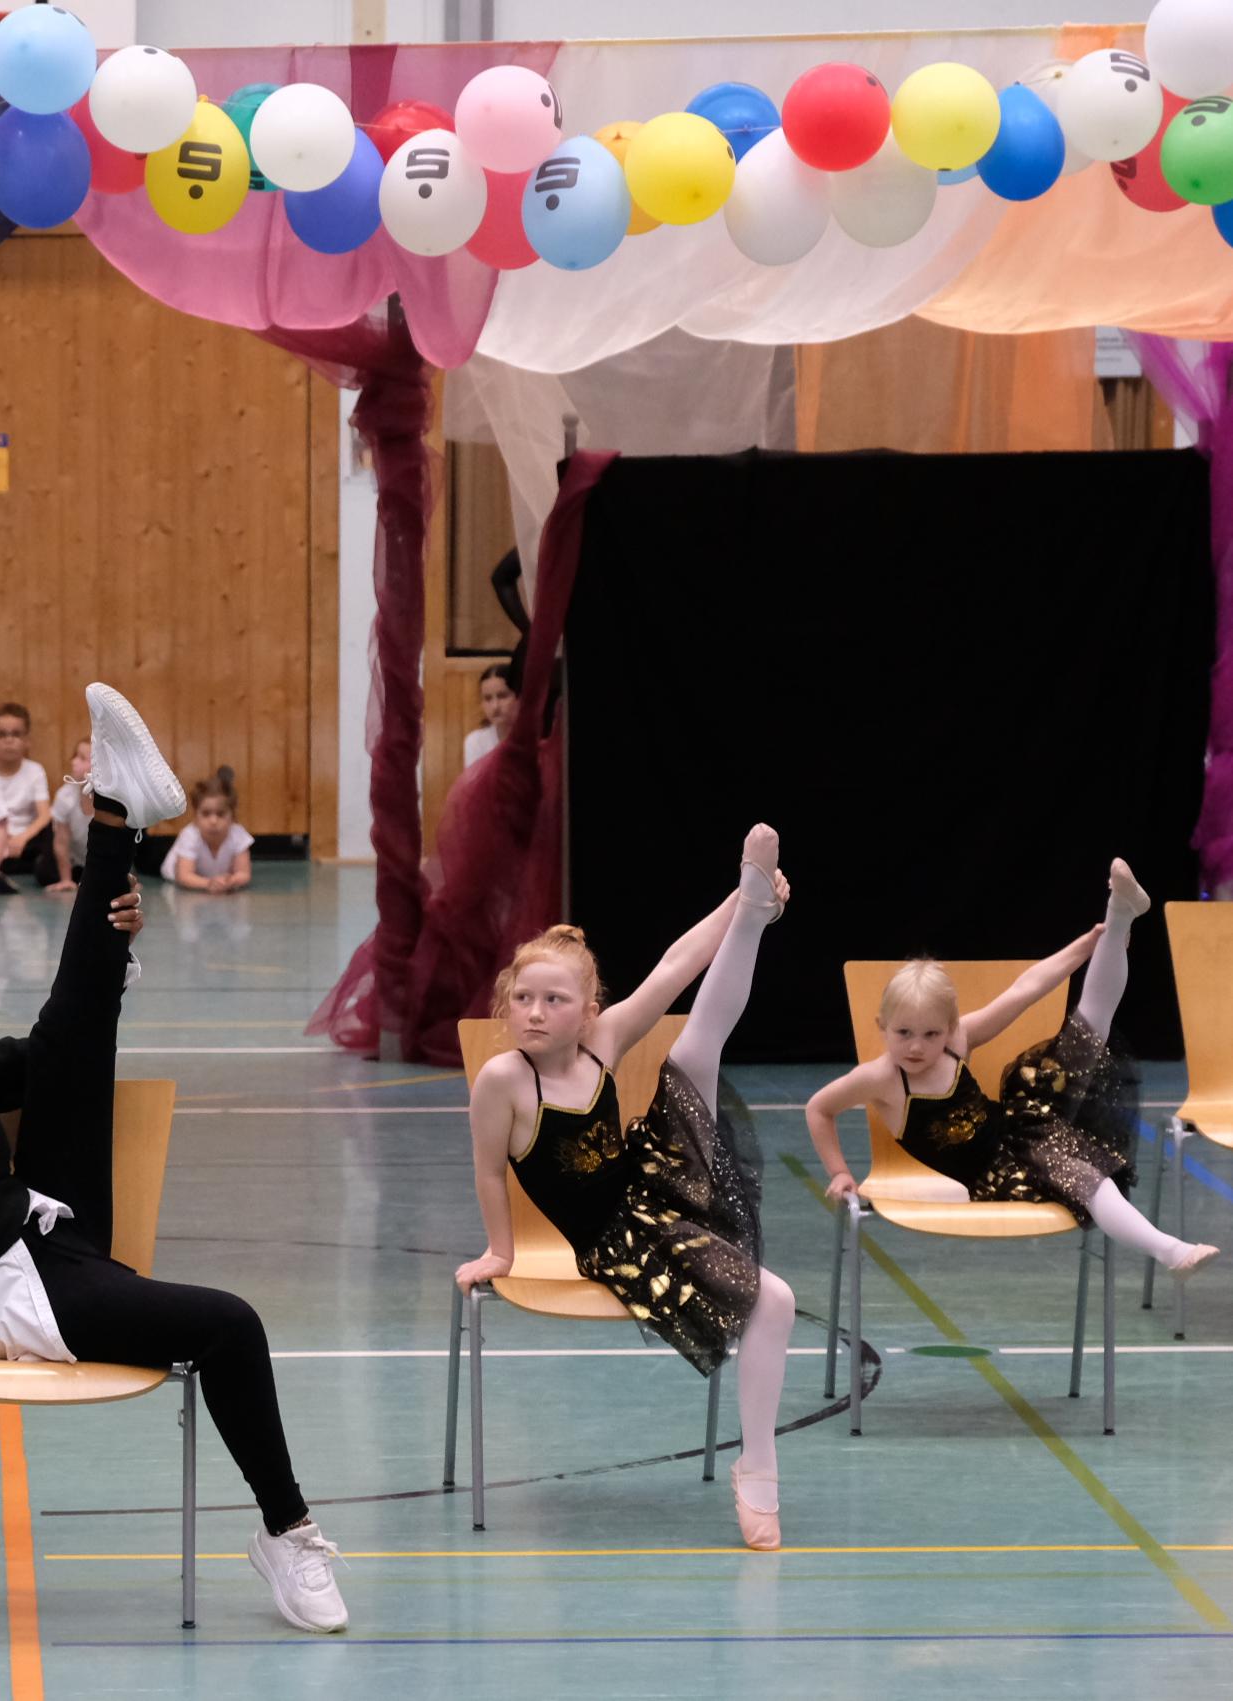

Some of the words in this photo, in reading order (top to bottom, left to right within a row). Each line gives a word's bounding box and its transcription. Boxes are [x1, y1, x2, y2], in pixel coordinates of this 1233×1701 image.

[1109, 52, 1150, 82] S
[177, 142, 222, 182] S
[406, 149, 450, 180] S
[535, 157, 581, 193] S
